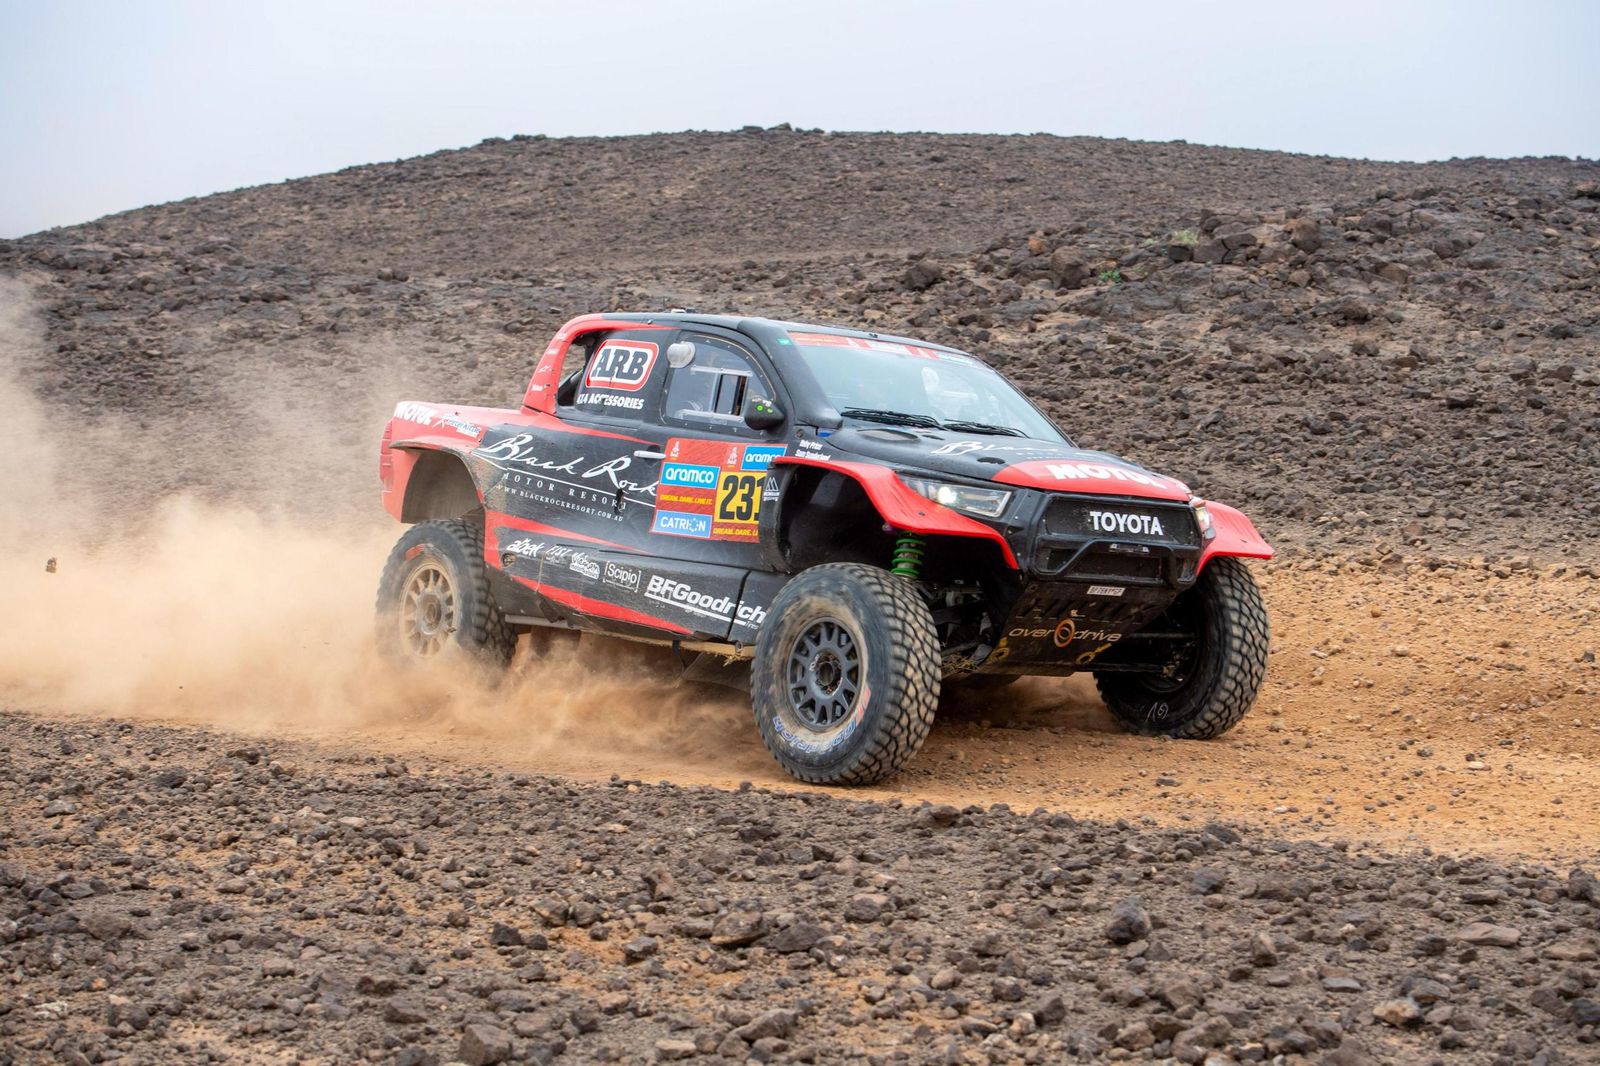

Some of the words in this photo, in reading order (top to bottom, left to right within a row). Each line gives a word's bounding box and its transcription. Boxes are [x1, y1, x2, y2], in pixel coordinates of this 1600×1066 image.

[591, 348, 649, 381] ARB
[474, 433, 577, 475] Black
[582, 455, 660, 497] Rock
[665, 468, 715, 484] aramco
[1046, 464, 1167, 489] MOTUL
[502, 472, 555, 491] MOTOR
[1089, 511, 1164, 536] TOYOTA
[607, 563, 638, 584] Scipio
[647, 575, 767, 624] BFGoodrich
